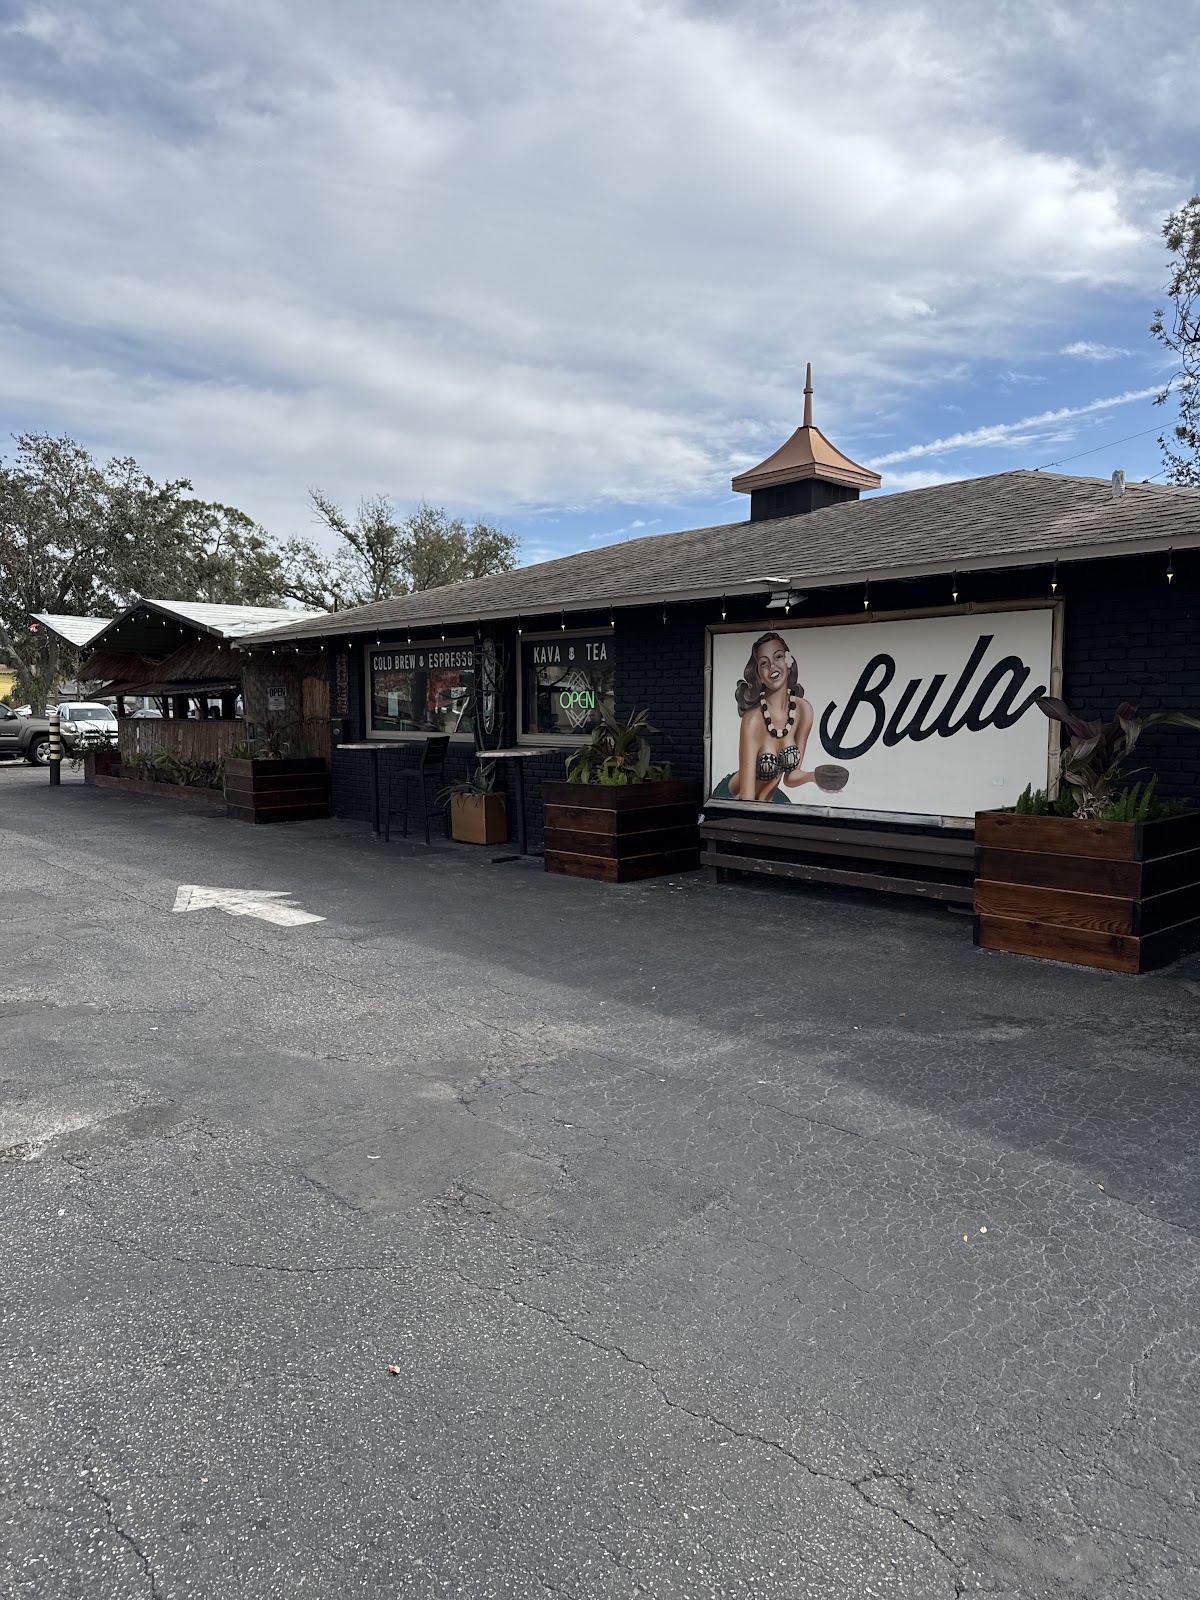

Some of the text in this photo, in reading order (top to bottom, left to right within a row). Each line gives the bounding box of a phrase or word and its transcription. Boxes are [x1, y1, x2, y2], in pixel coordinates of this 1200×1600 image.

[373, 656, 392, 671] COLD
[395, 654, 416, 670] BREW
[428, 650, 473, 669] ESPRESSO
[533, 645, 561, 664] KAVA
[586, 642, 607, 661] TEA
[269, 686, 286, 697] OPEN
[559, 690, 595, 709] OPEN
[819, 634, 1047, 760] Bula
